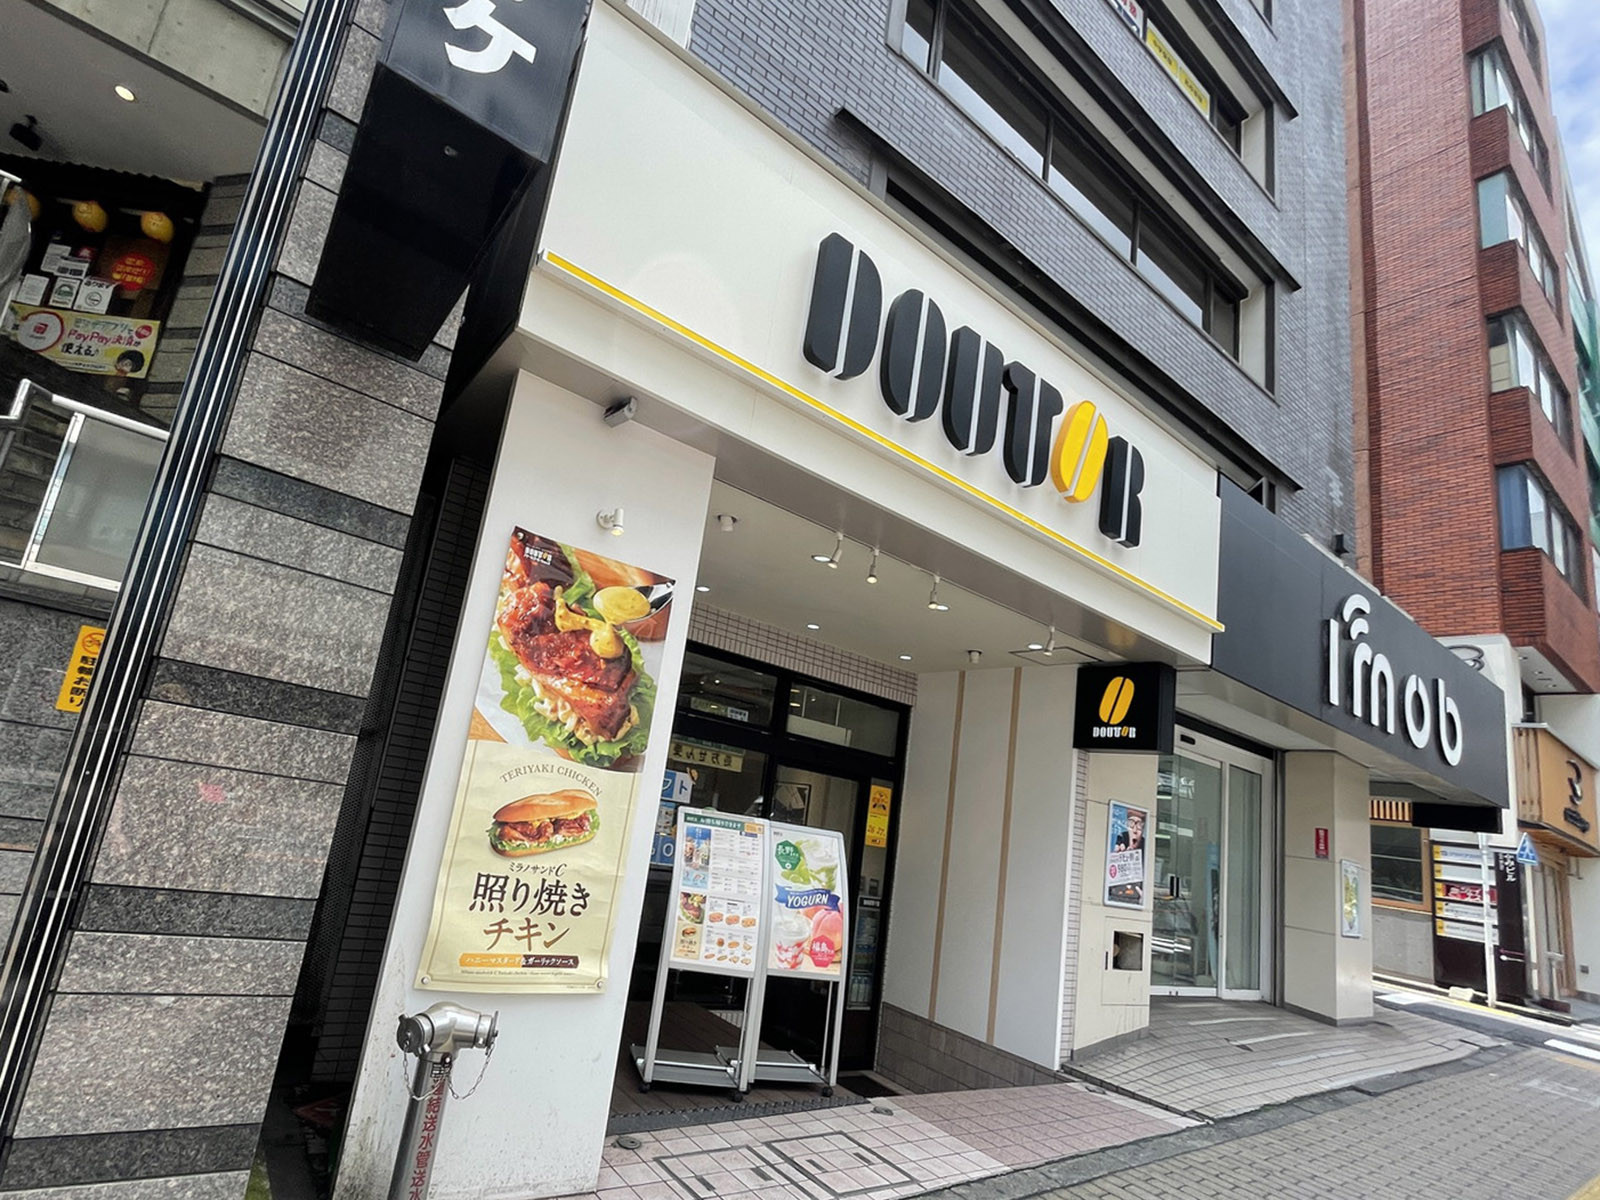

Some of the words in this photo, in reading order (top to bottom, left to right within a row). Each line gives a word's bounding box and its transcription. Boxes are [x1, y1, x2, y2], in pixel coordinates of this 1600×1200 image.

[802, 232, 1146, 549] DOUTOR
[1092, 726, 1137, 739] DOUTOR
[499, 763, 555, 783] TERIYAKI
[557, 765, 603, 797] CHICKEN
[509, 861, 567, 878] ミラノサンドC
[468, 872, 591, 917] 照り焼き
[787, 893, 829, 908] YOGURN
[483, 917, 571, 952] チキン
